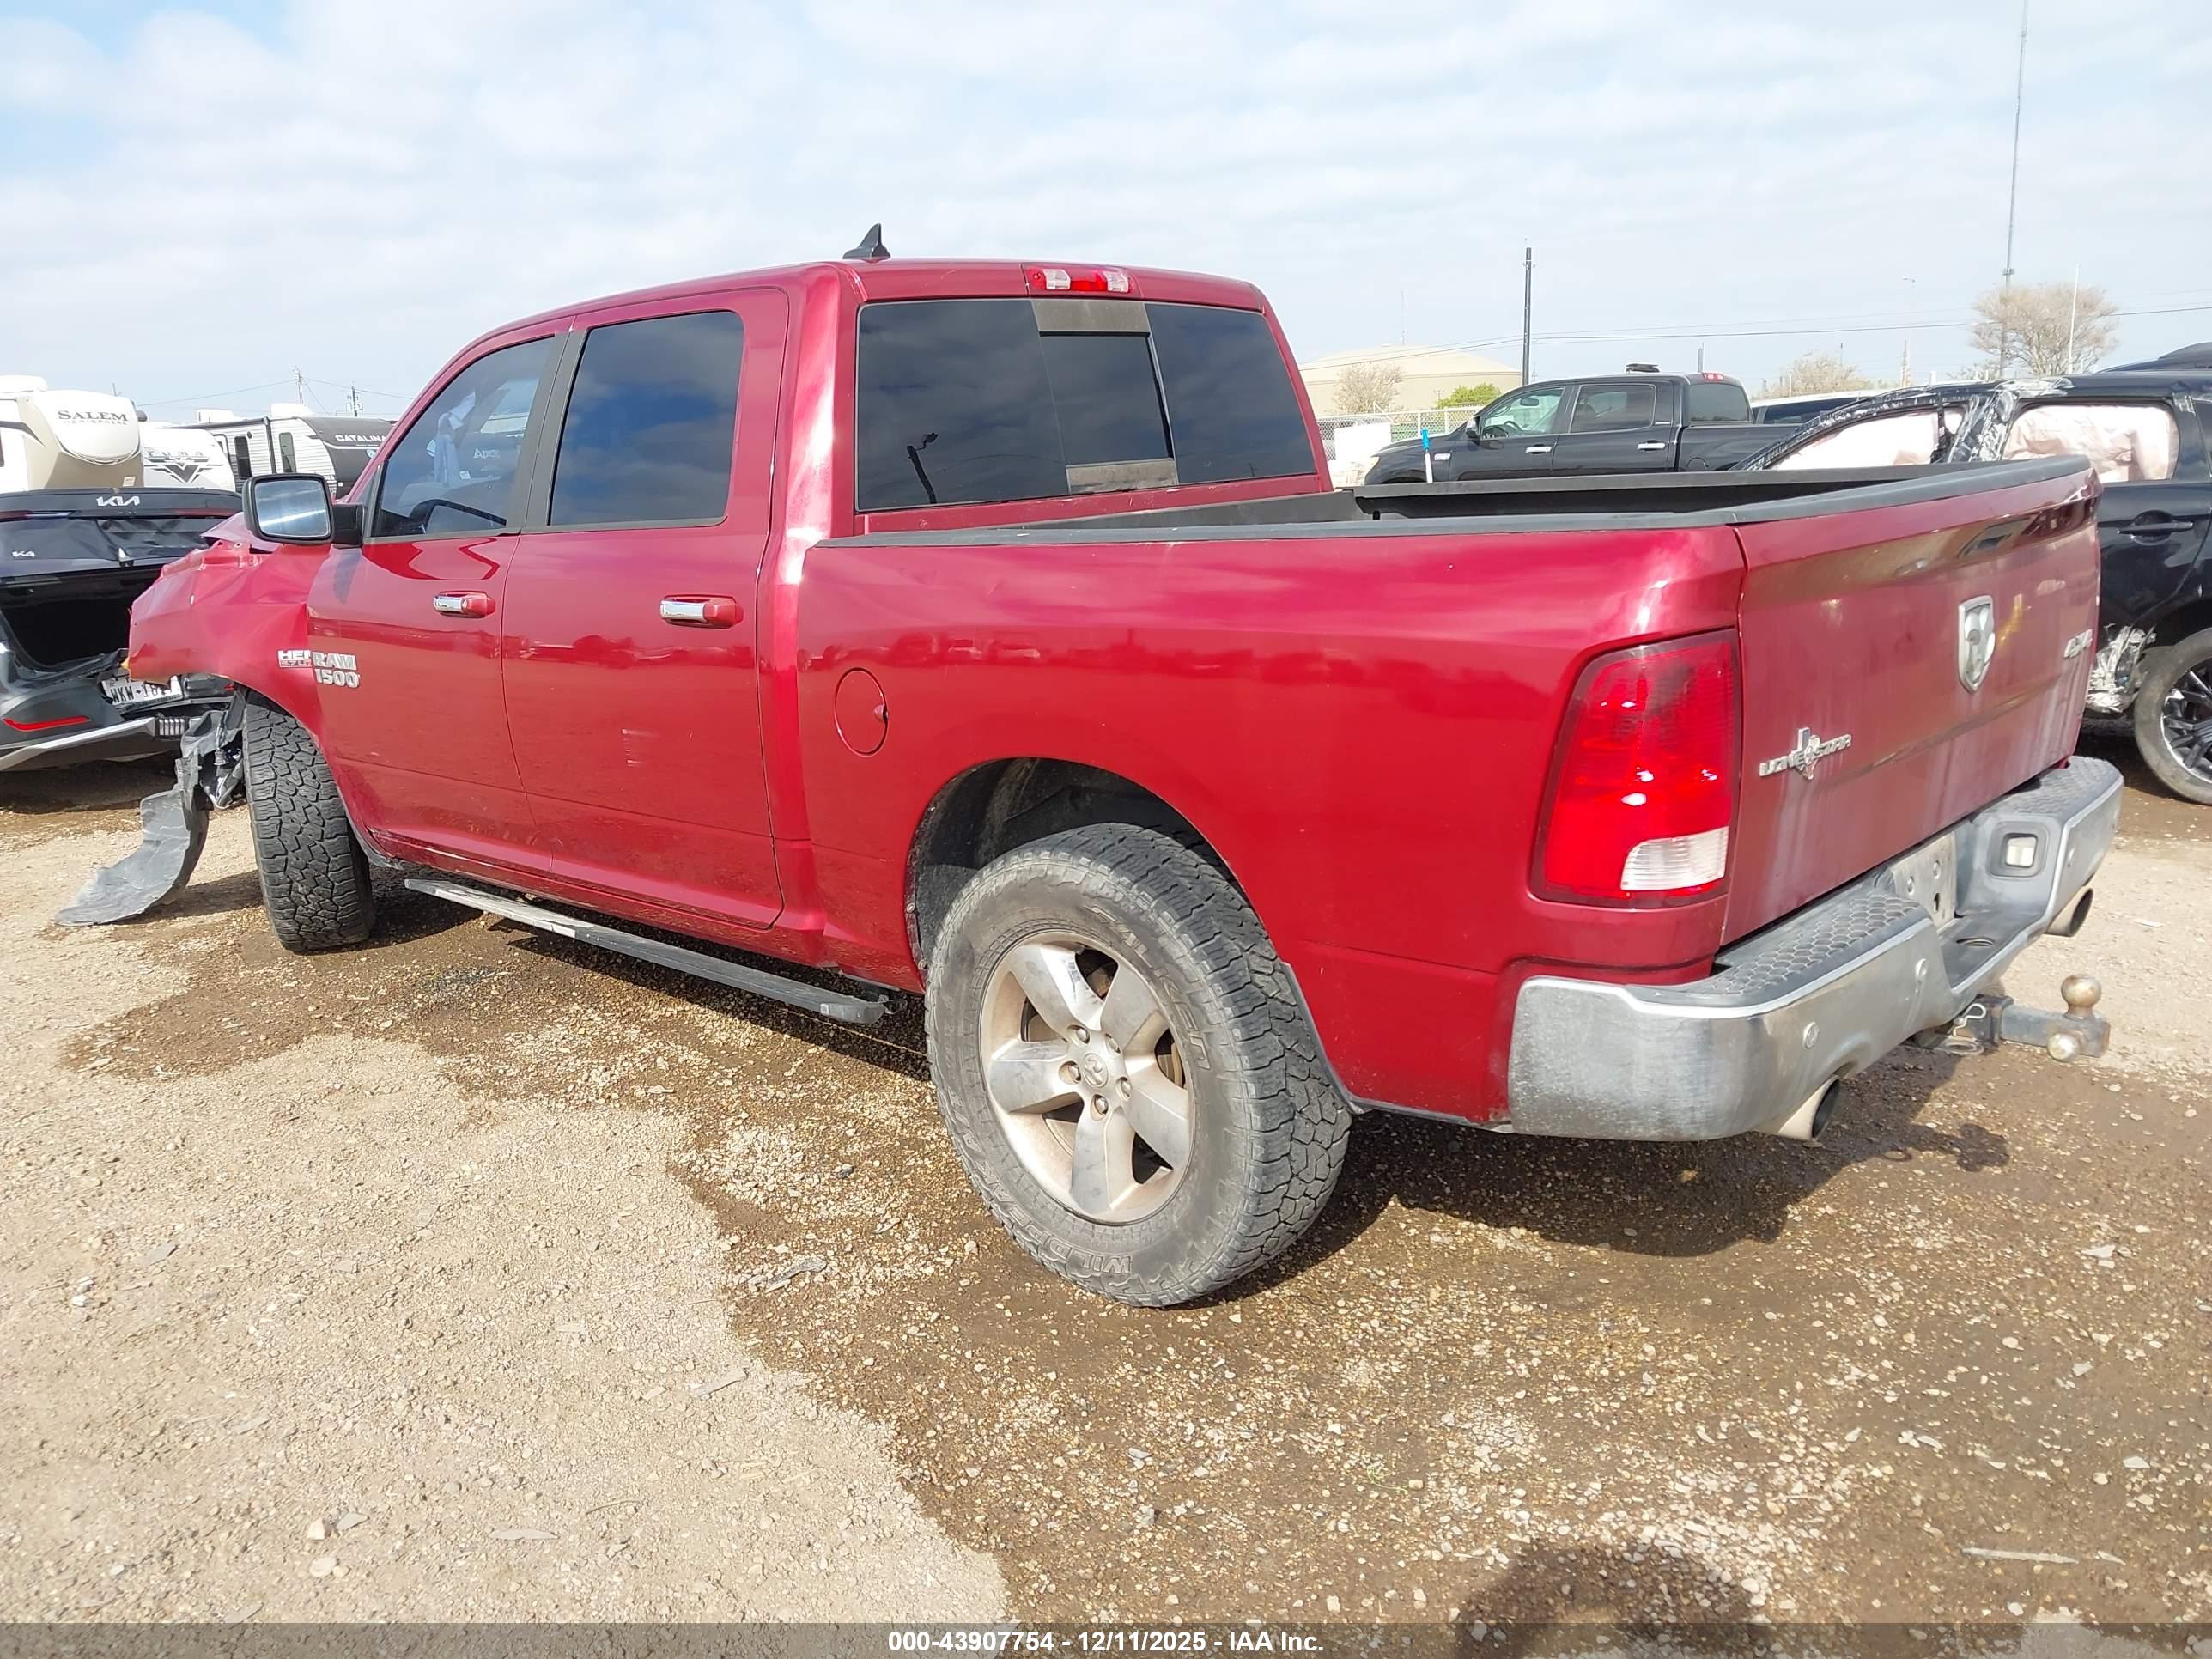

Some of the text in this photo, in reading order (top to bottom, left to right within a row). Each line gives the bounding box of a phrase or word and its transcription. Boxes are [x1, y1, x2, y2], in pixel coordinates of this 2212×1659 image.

[58, 410, 129, 422] SALEM
[96, 495, 140, 507] KIA
[312, 651, 357, 671] RAM
[314, 669, 361, 689] 1500
